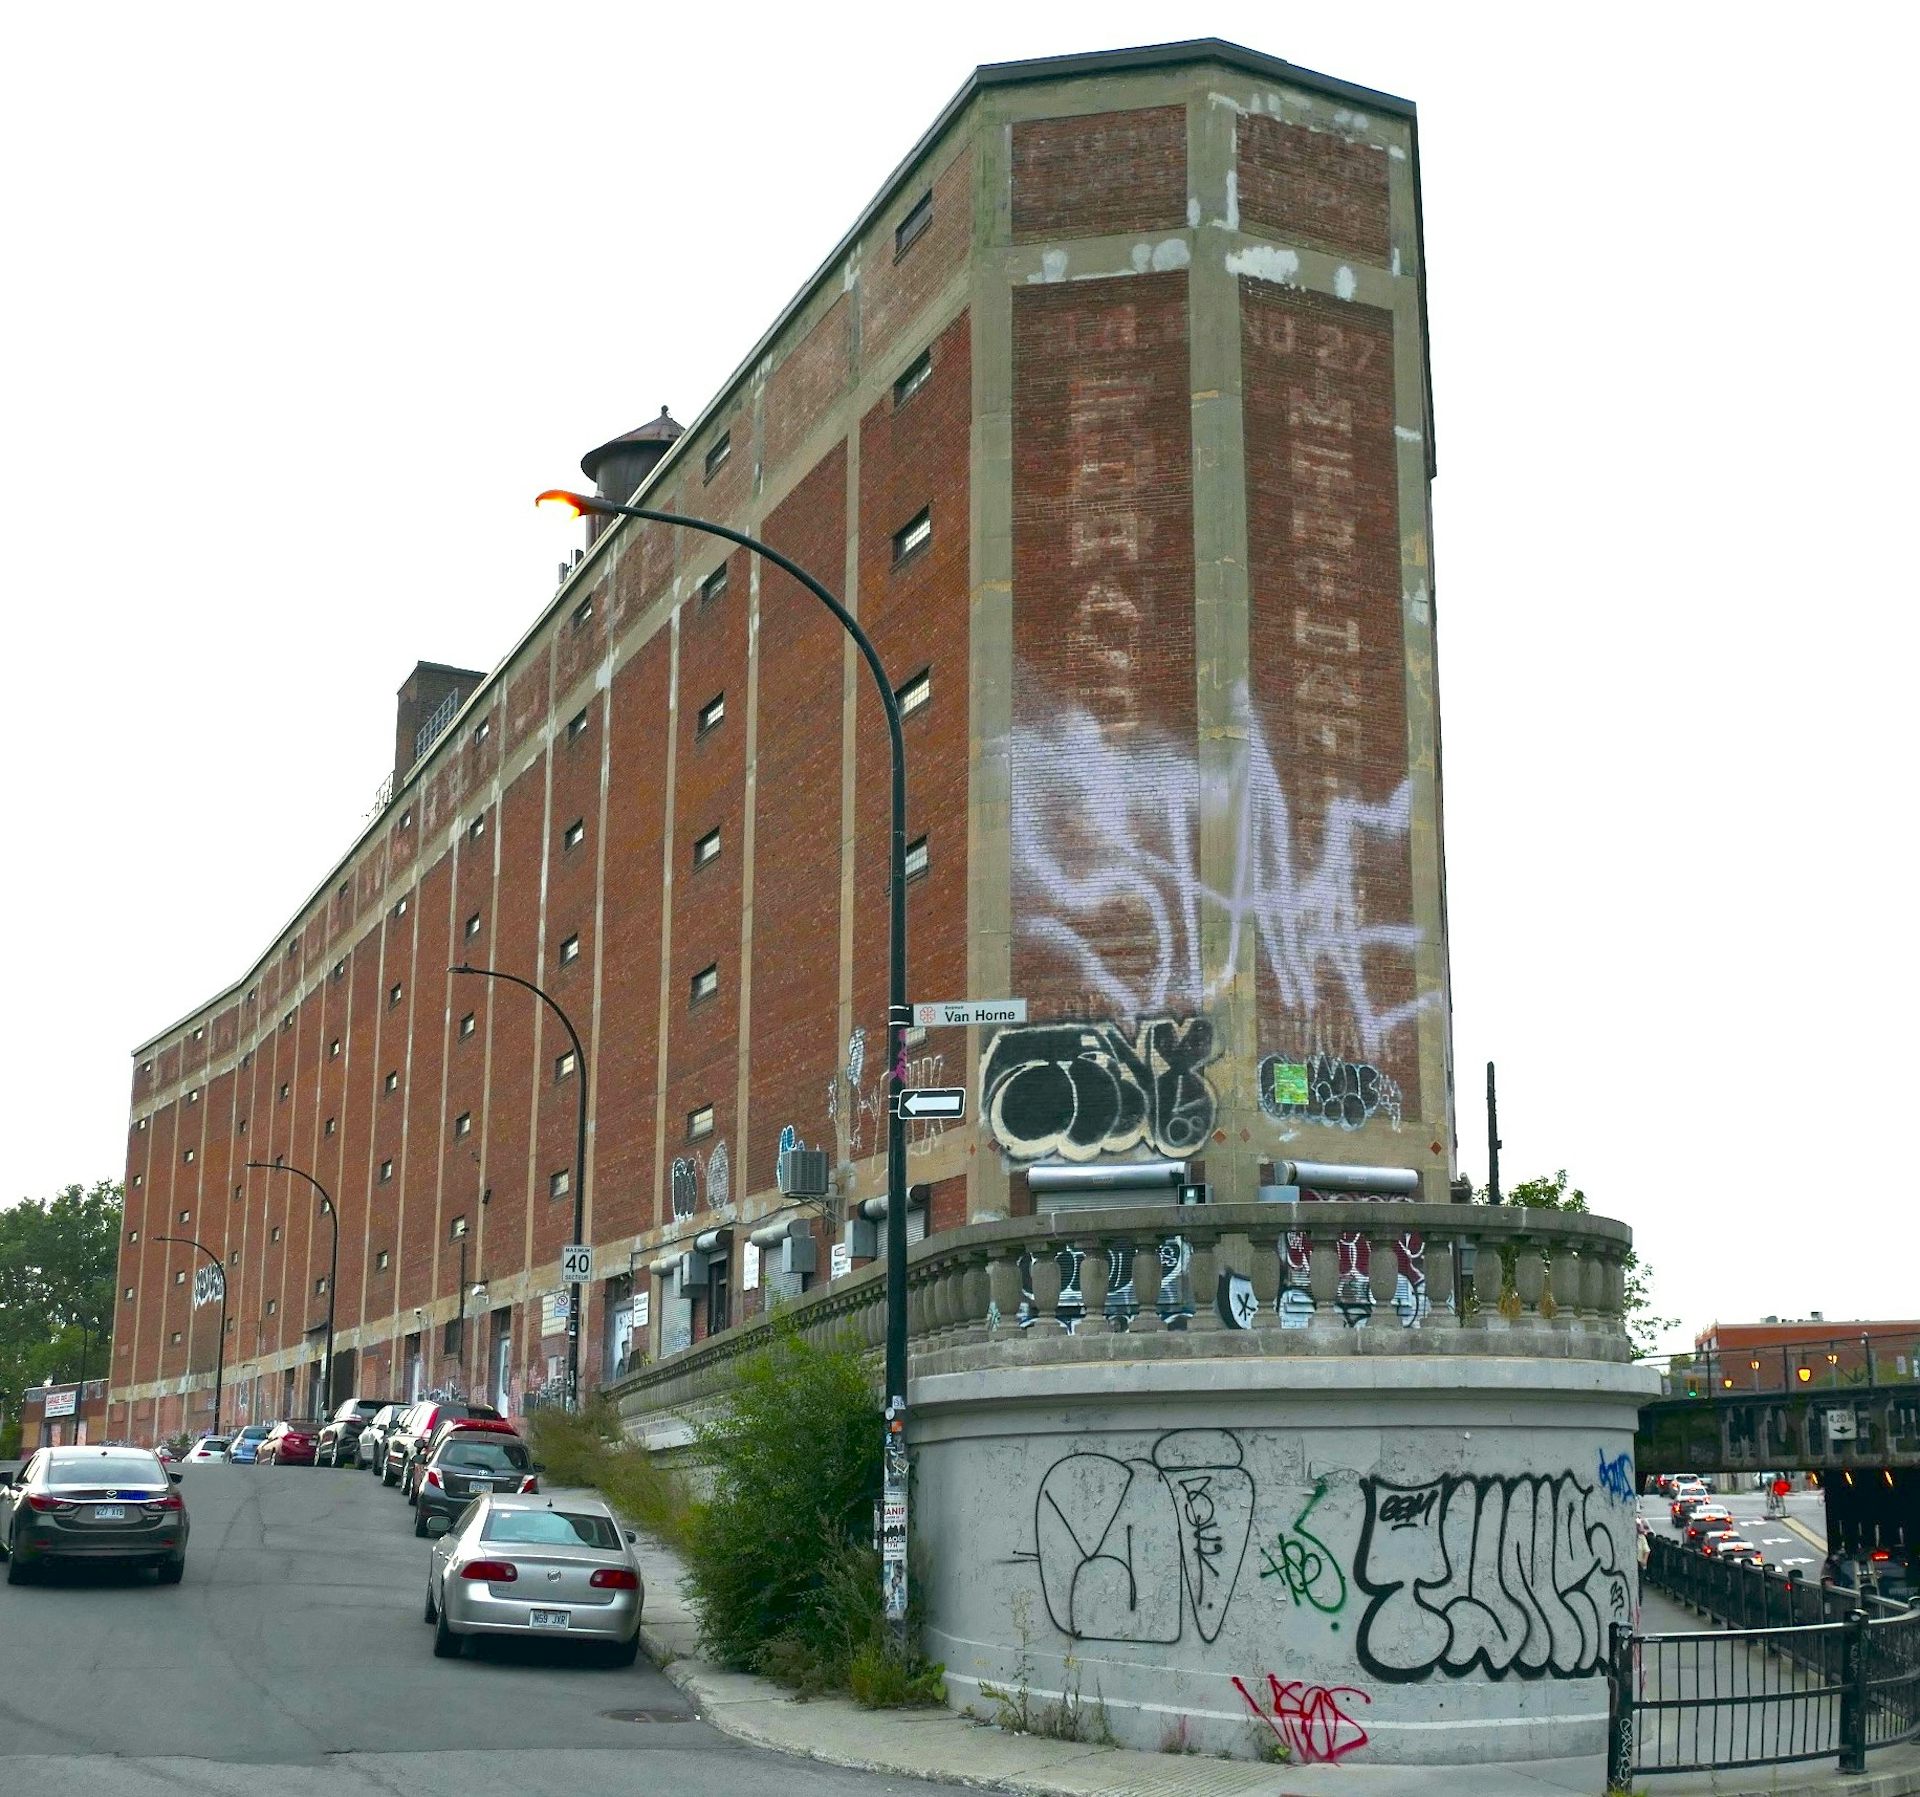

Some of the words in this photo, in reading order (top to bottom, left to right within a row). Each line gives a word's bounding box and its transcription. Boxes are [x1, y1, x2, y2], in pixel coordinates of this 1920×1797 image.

[944, 1010, 970, 1022] Van
[975, 1009, 1016, 1021] Horne
[565, 1254, 590, 1273] 40
